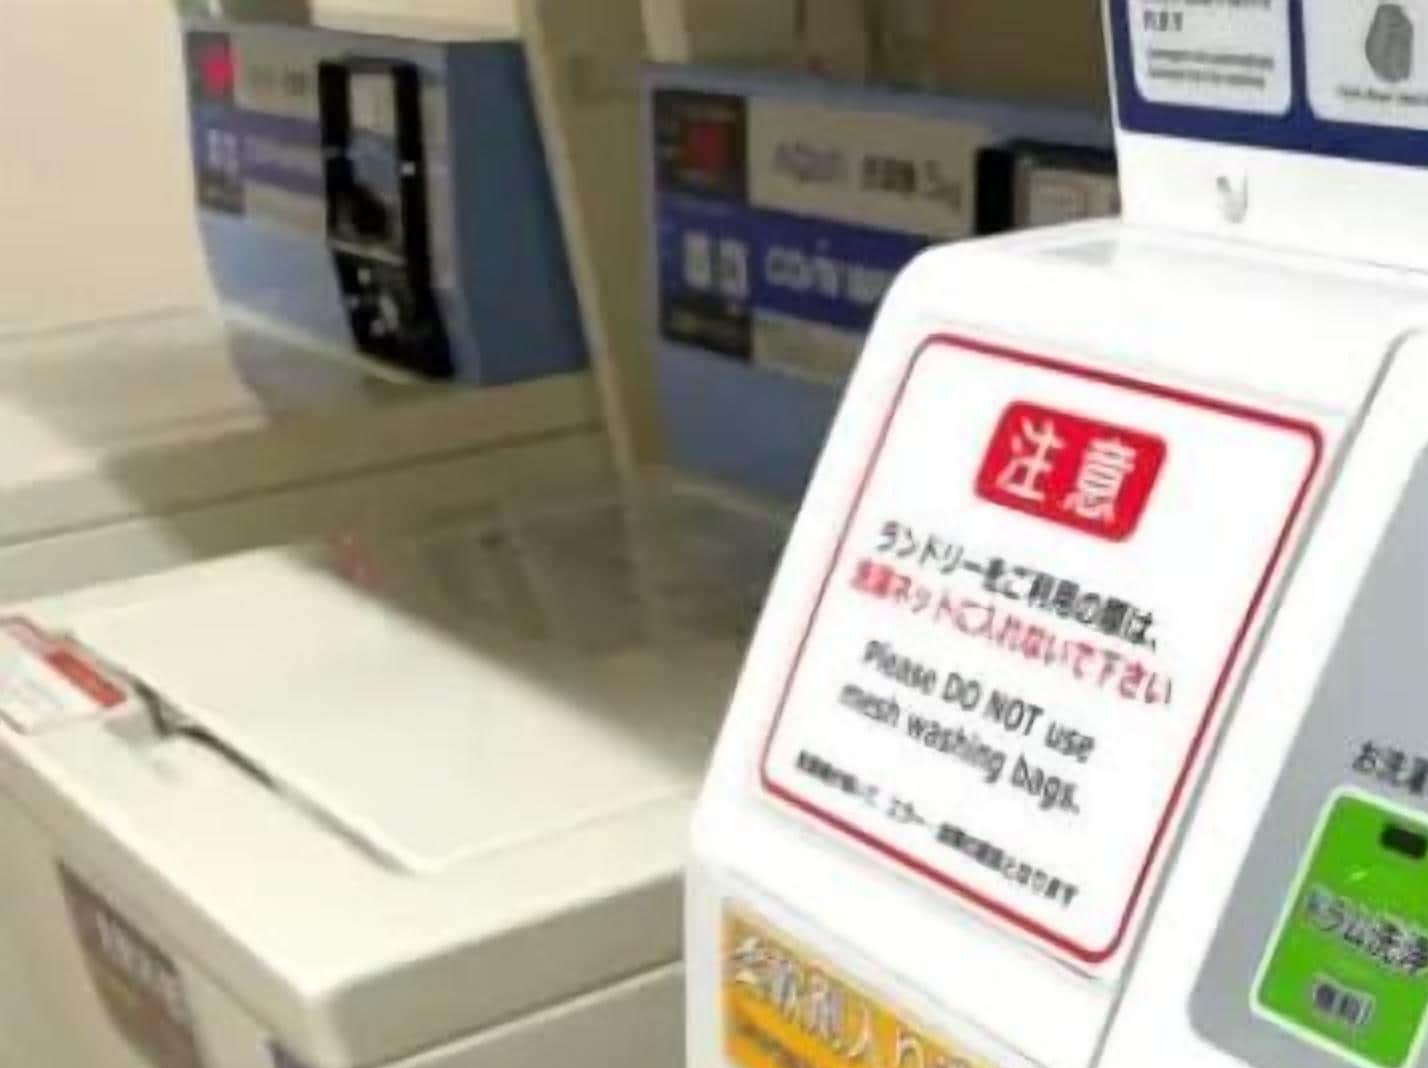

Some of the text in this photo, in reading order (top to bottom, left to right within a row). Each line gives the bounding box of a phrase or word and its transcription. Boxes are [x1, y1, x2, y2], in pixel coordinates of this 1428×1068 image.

[997, 414, 1138, 523] 注意
[837, 683, 901, 730] mesh
[906, 715, 1007, 784] washing
[1010, 753, 1081, 816] bags.
[862, 639, 1096, 763] Please DO NOT use
